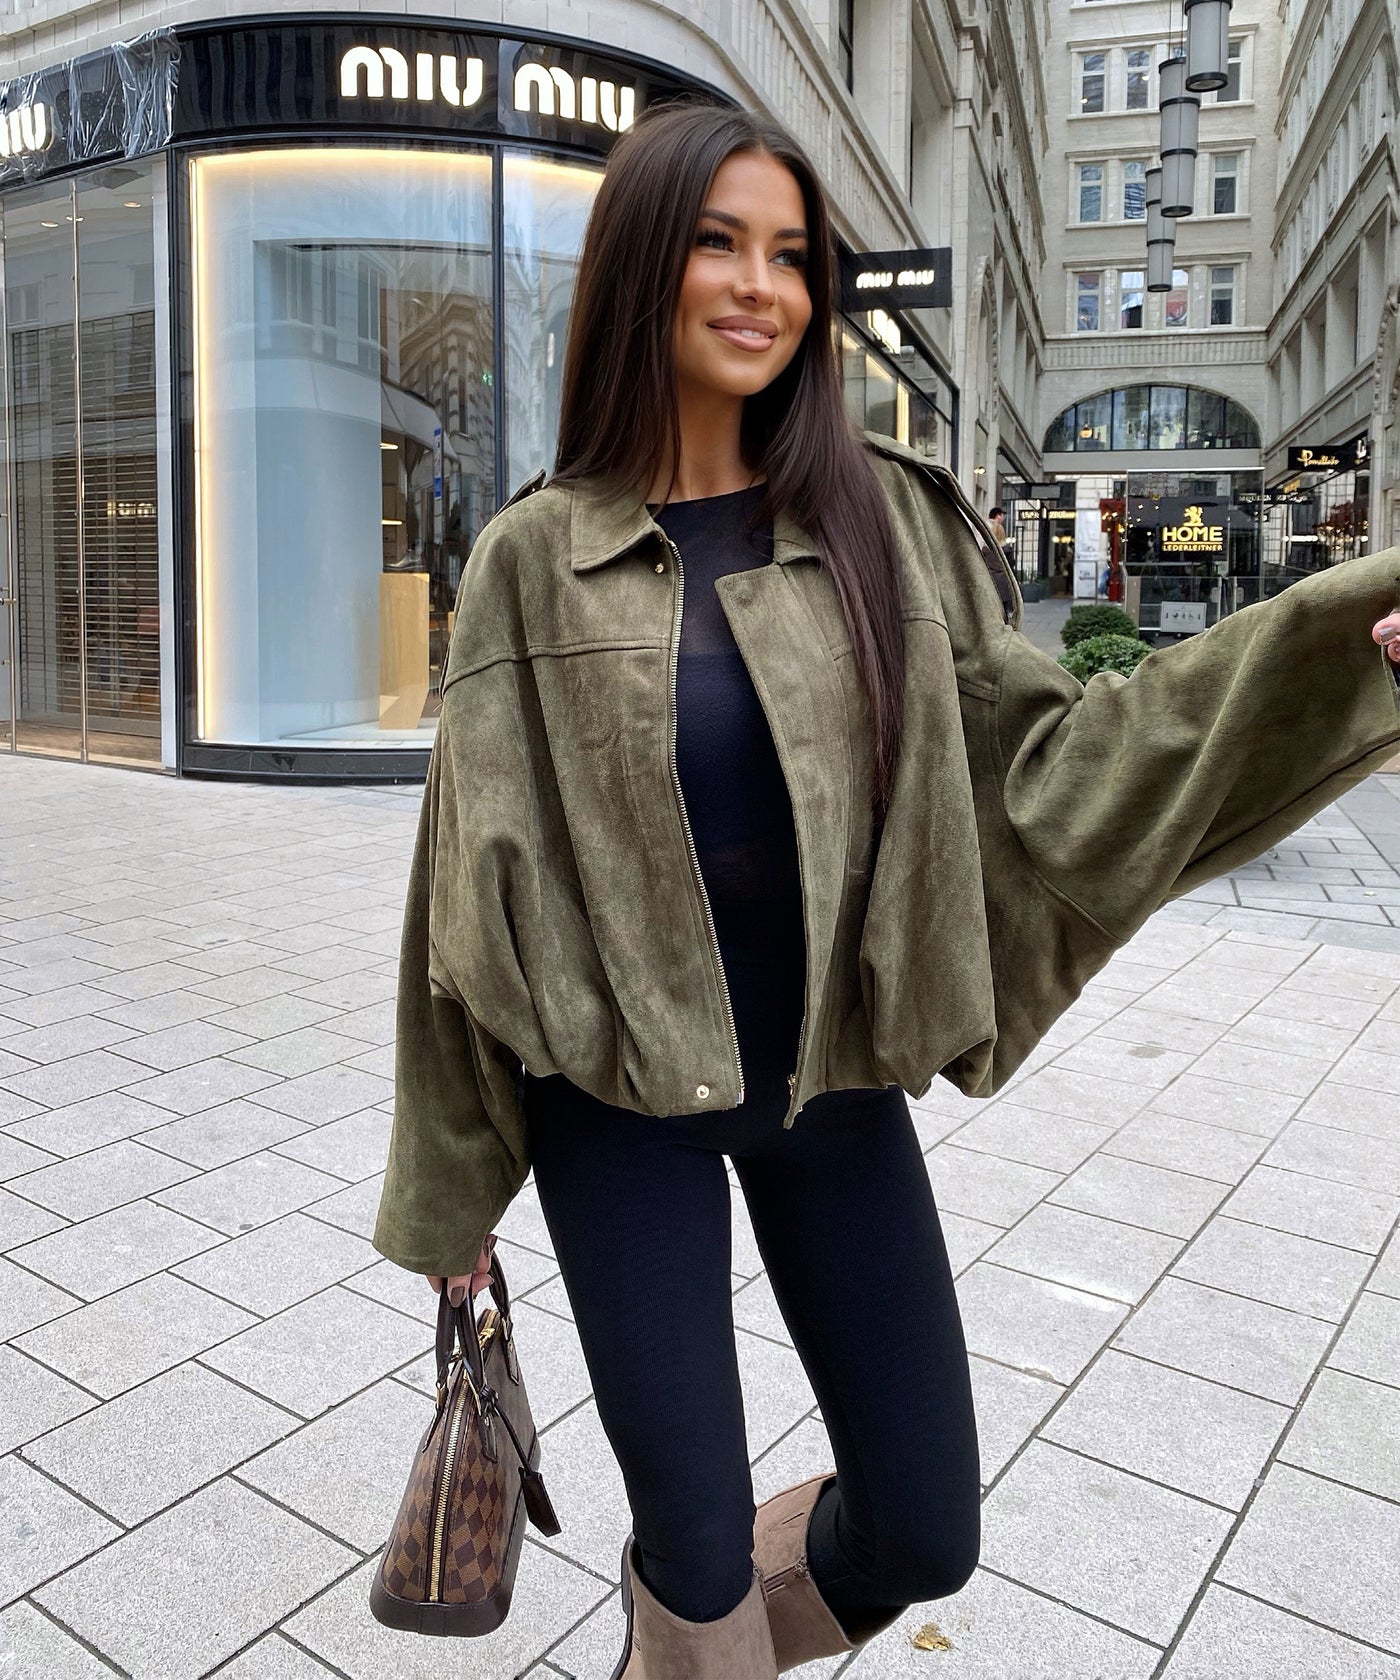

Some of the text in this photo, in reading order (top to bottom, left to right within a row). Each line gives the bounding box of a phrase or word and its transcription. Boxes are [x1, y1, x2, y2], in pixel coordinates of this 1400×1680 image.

[0, 102, 47, 158] IU
[1162, 526, 1224, 542] HOME
[1162, 544, 1223, 552] LEDERLEITNER
